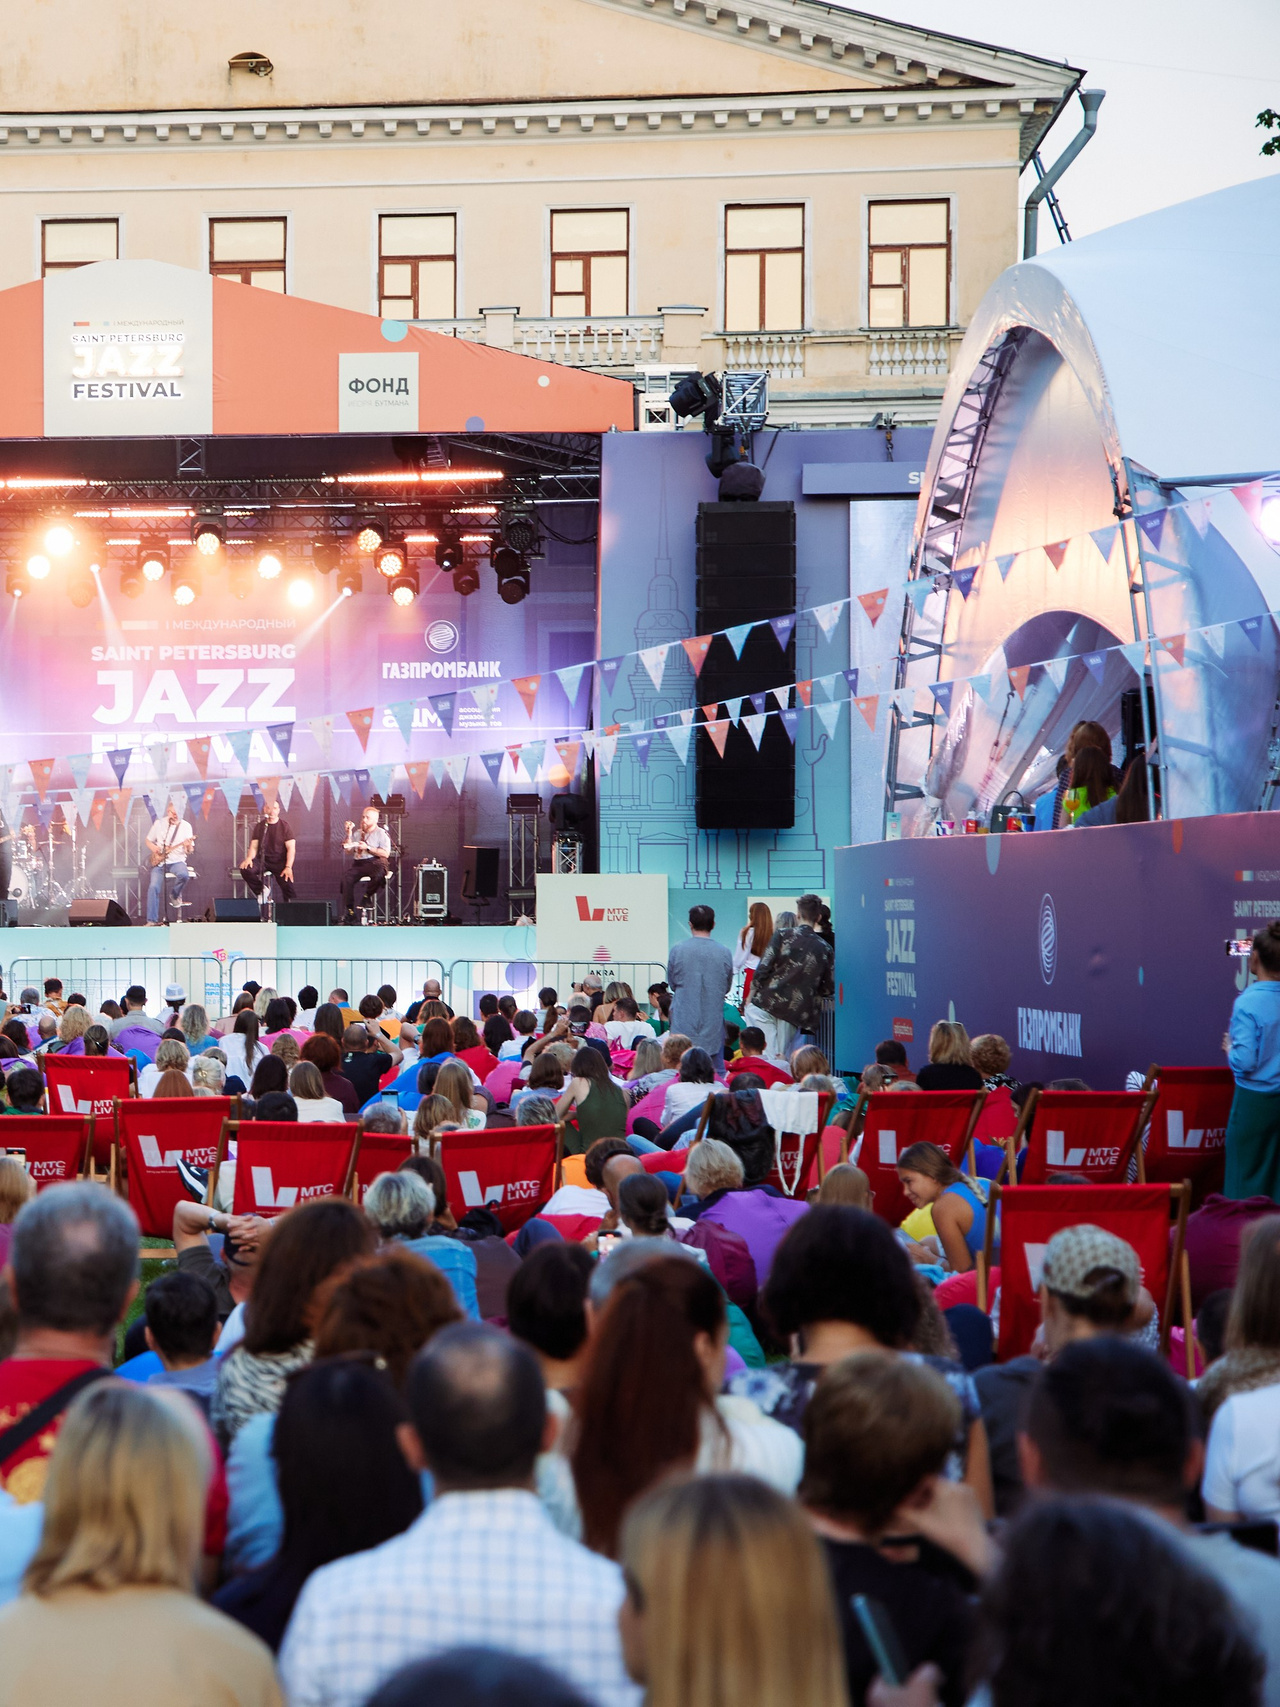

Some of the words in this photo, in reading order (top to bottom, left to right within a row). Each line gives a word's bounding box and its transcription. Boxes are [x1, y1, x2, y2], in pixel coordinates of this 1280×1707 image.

[72, 334, 106, 343] SAINT
[109, 333, 184, 343] PETERSBURG
[72, 345, 184, 379] JAZZ
[73, 382, 182, 399] FESTIVAL
[348, 377, 410, 396] ФОНД
[172, 618, 297, 631] МЕЖДУНАРОДНЫЙ
[91, 645, 154, 662] SAINT
[159, 643, 297, 661] PETERSBURG
[381, 660, 502, 679] ГАЗПРОМБАНК
[91, 667, 297, 725] JAZZ
[606, 914, 629, 922] LIVE
[886, 918, 916, 964] JAZZ
[886, 970, 918, 998] FESTIVAL
[1018, 1006, 1083, 1059] ГАЗПРОМБАНК
[1086, 1156, 1119, 1166] LIVE
[33, 1168, 66, 1177] LIVE
[506, 1188, 540, 1201] LIVE
